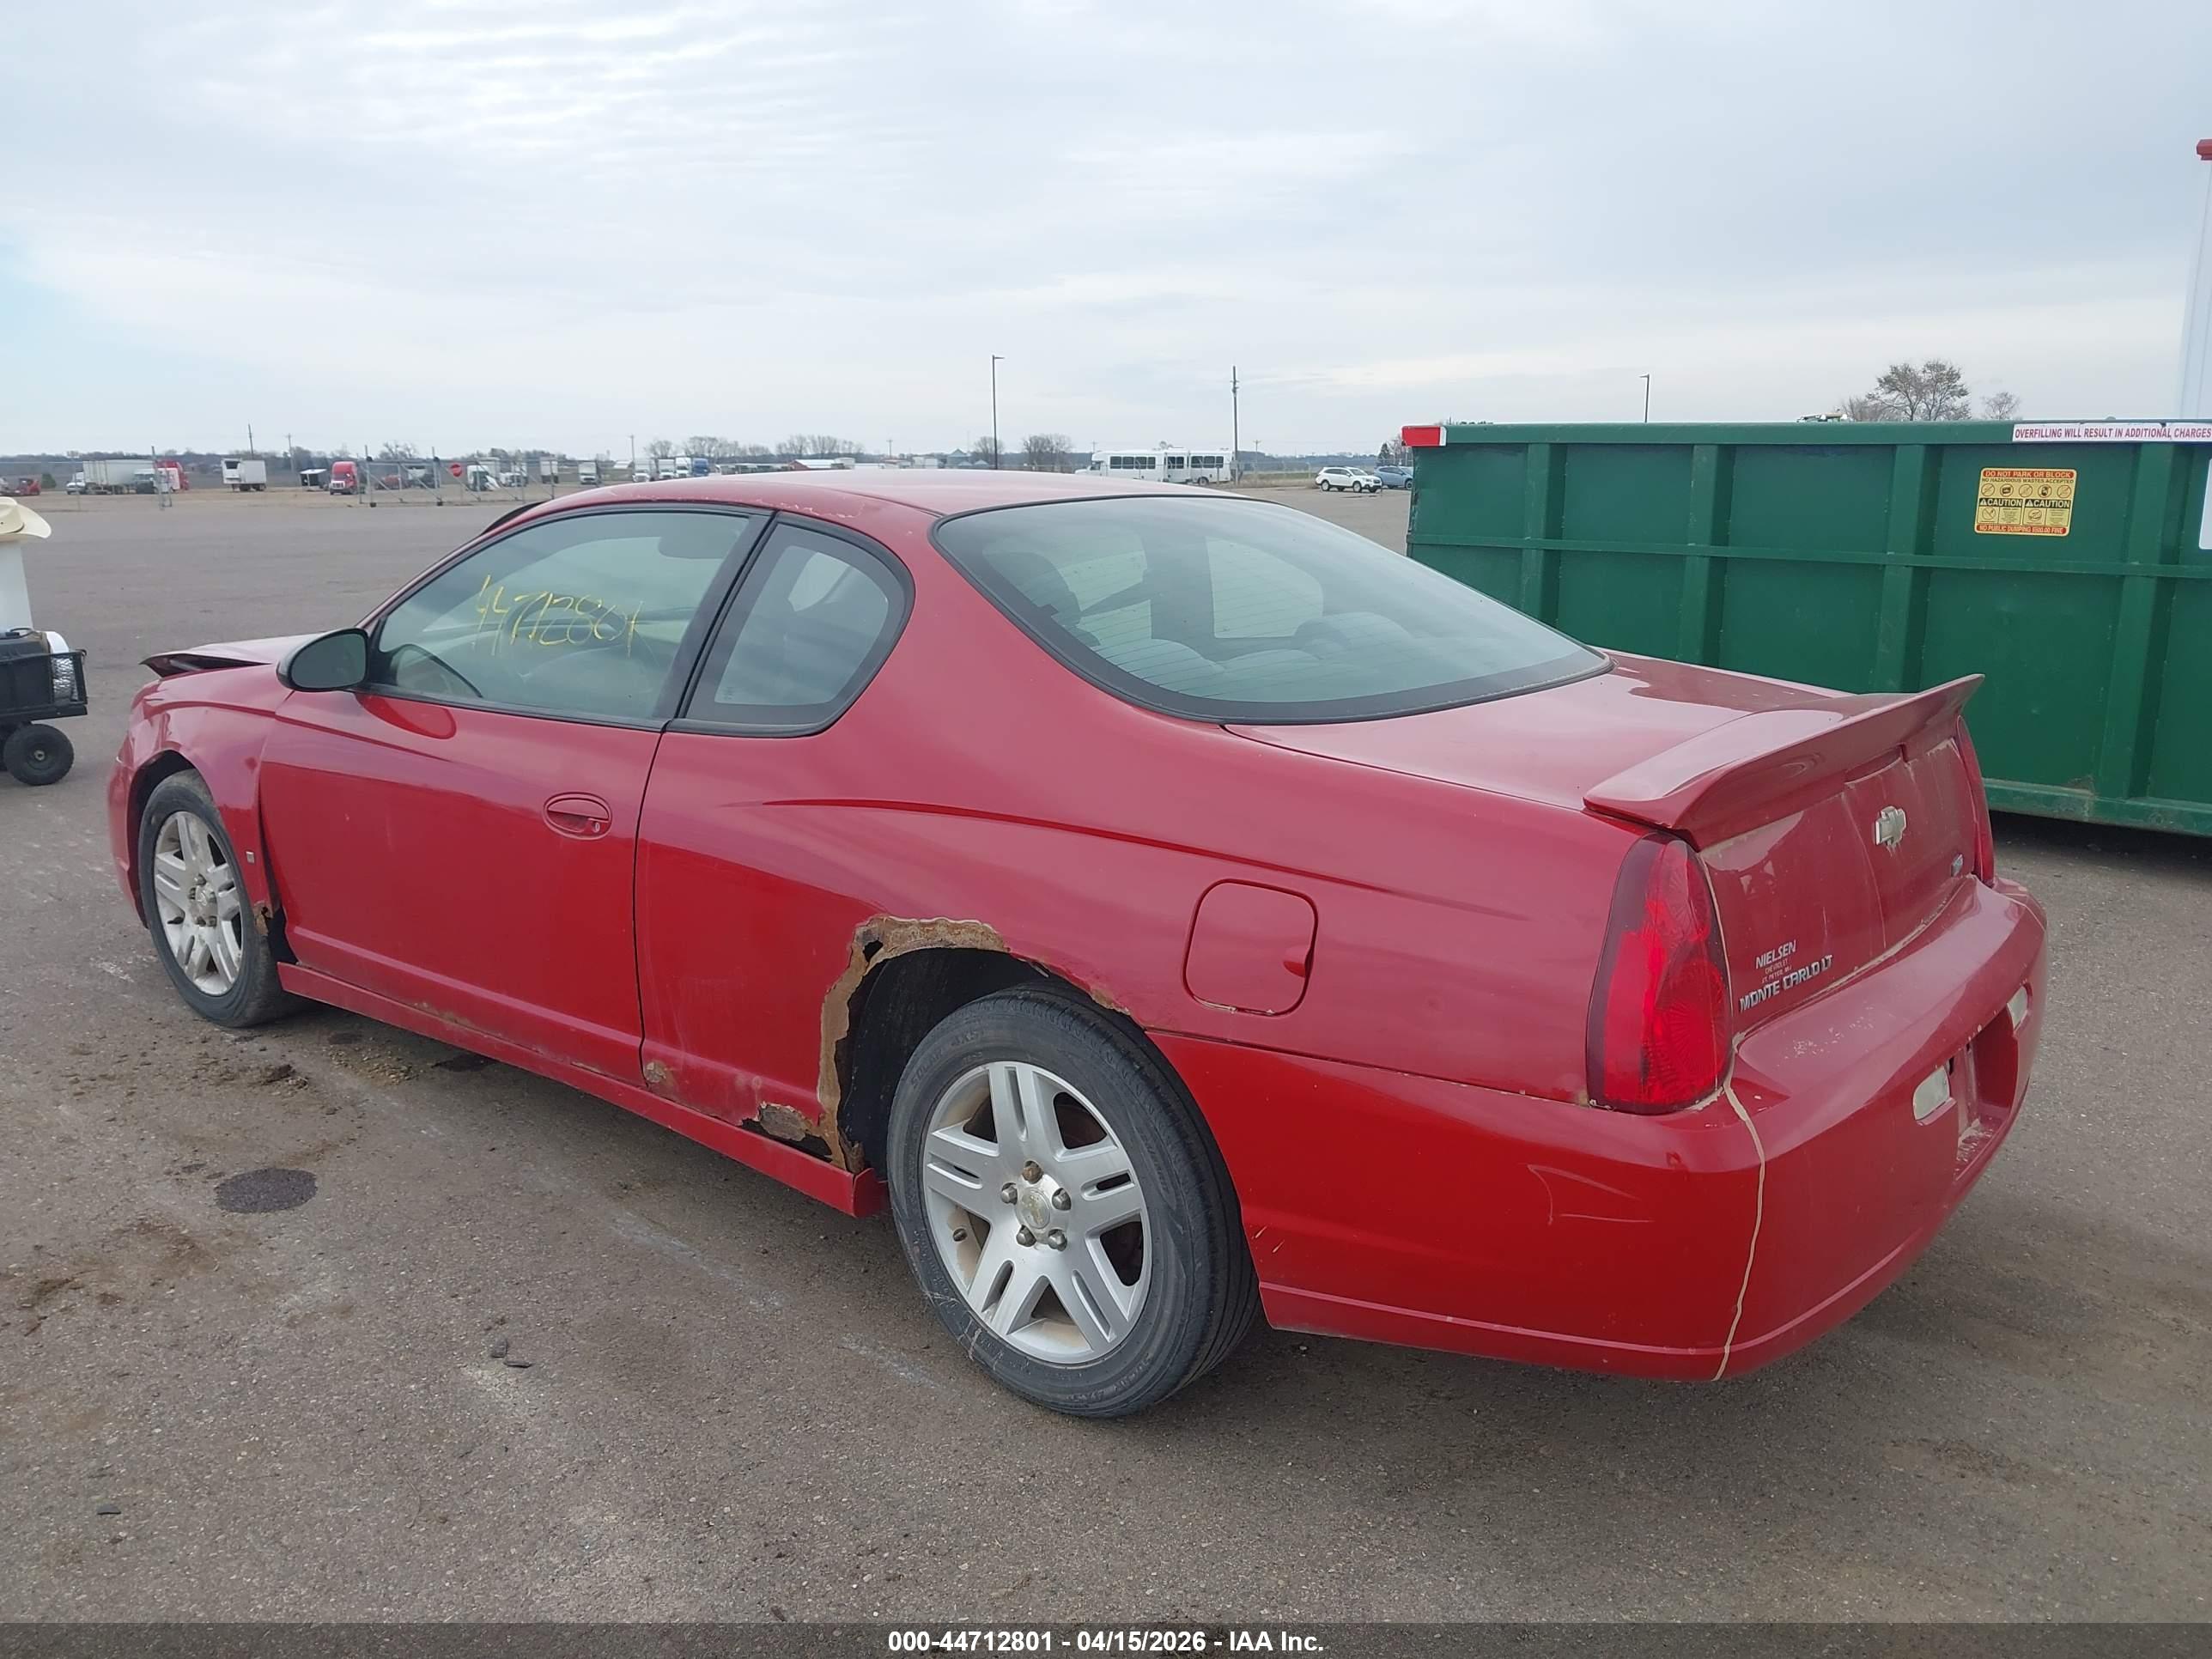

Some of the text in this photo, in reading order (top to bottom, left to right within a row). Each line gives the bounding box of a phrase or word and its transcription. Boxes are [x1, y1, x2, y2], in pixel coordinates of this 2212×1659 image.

[2015, 427, 2212, 439] OVERFILLING WILL RESULT IN ADDITIONAL CHARGES
[1756, 939, 1796, 969] NIELSEN
[1739, 954, 1832, 1013] MONTE CARLO LT
